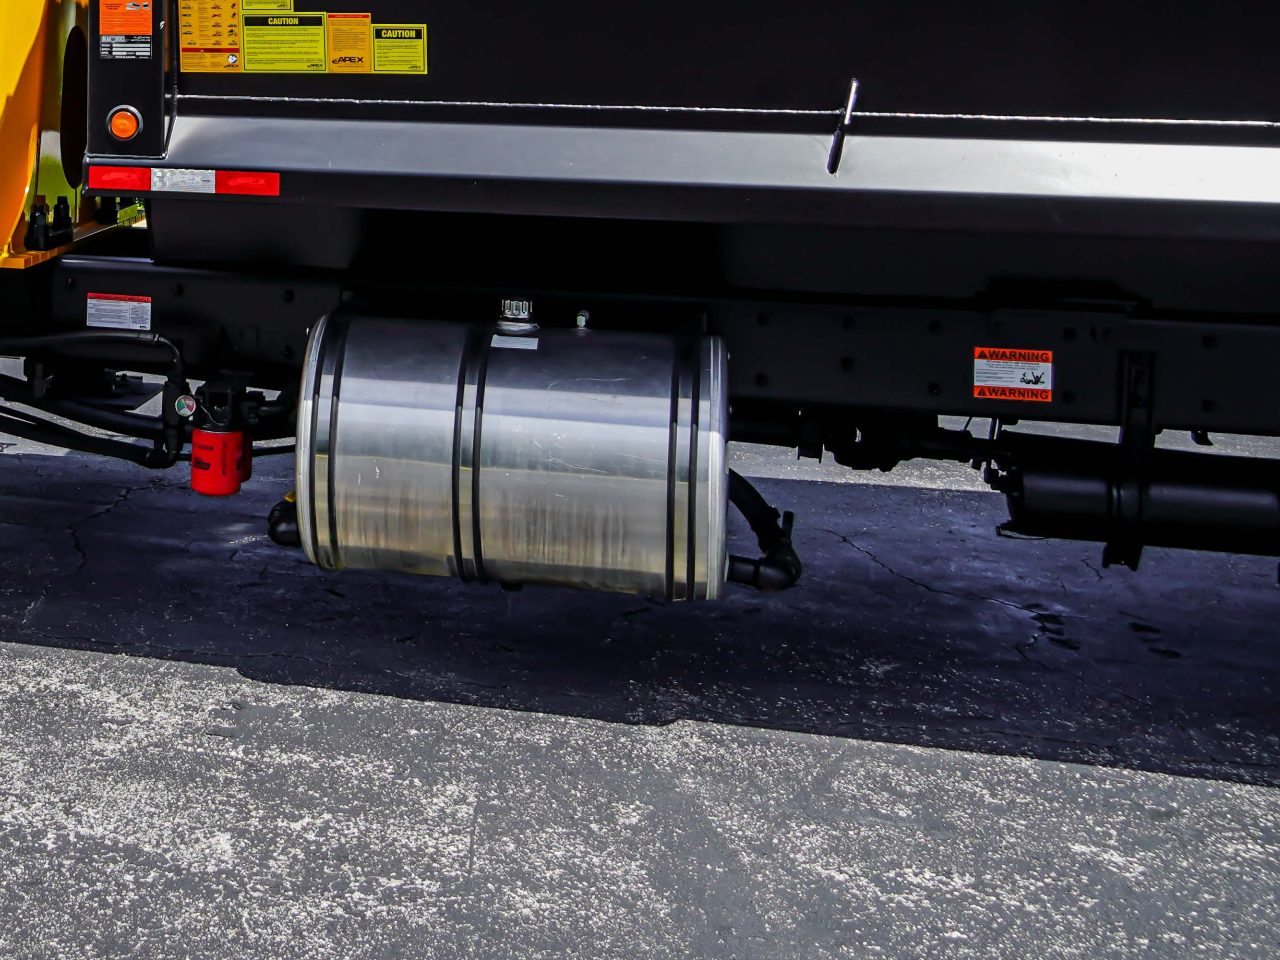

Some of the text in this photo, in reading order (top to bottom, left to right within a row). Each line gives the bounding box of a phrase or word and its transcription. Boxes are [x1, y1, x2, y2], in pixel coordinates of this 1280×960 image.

[268, 17, 299, 25] CAUTION
[381, 29, 416, 38] CAUTION
[987, 349, 1049, 362] WARNING
[987, 387, 1049, 400] WARNING
